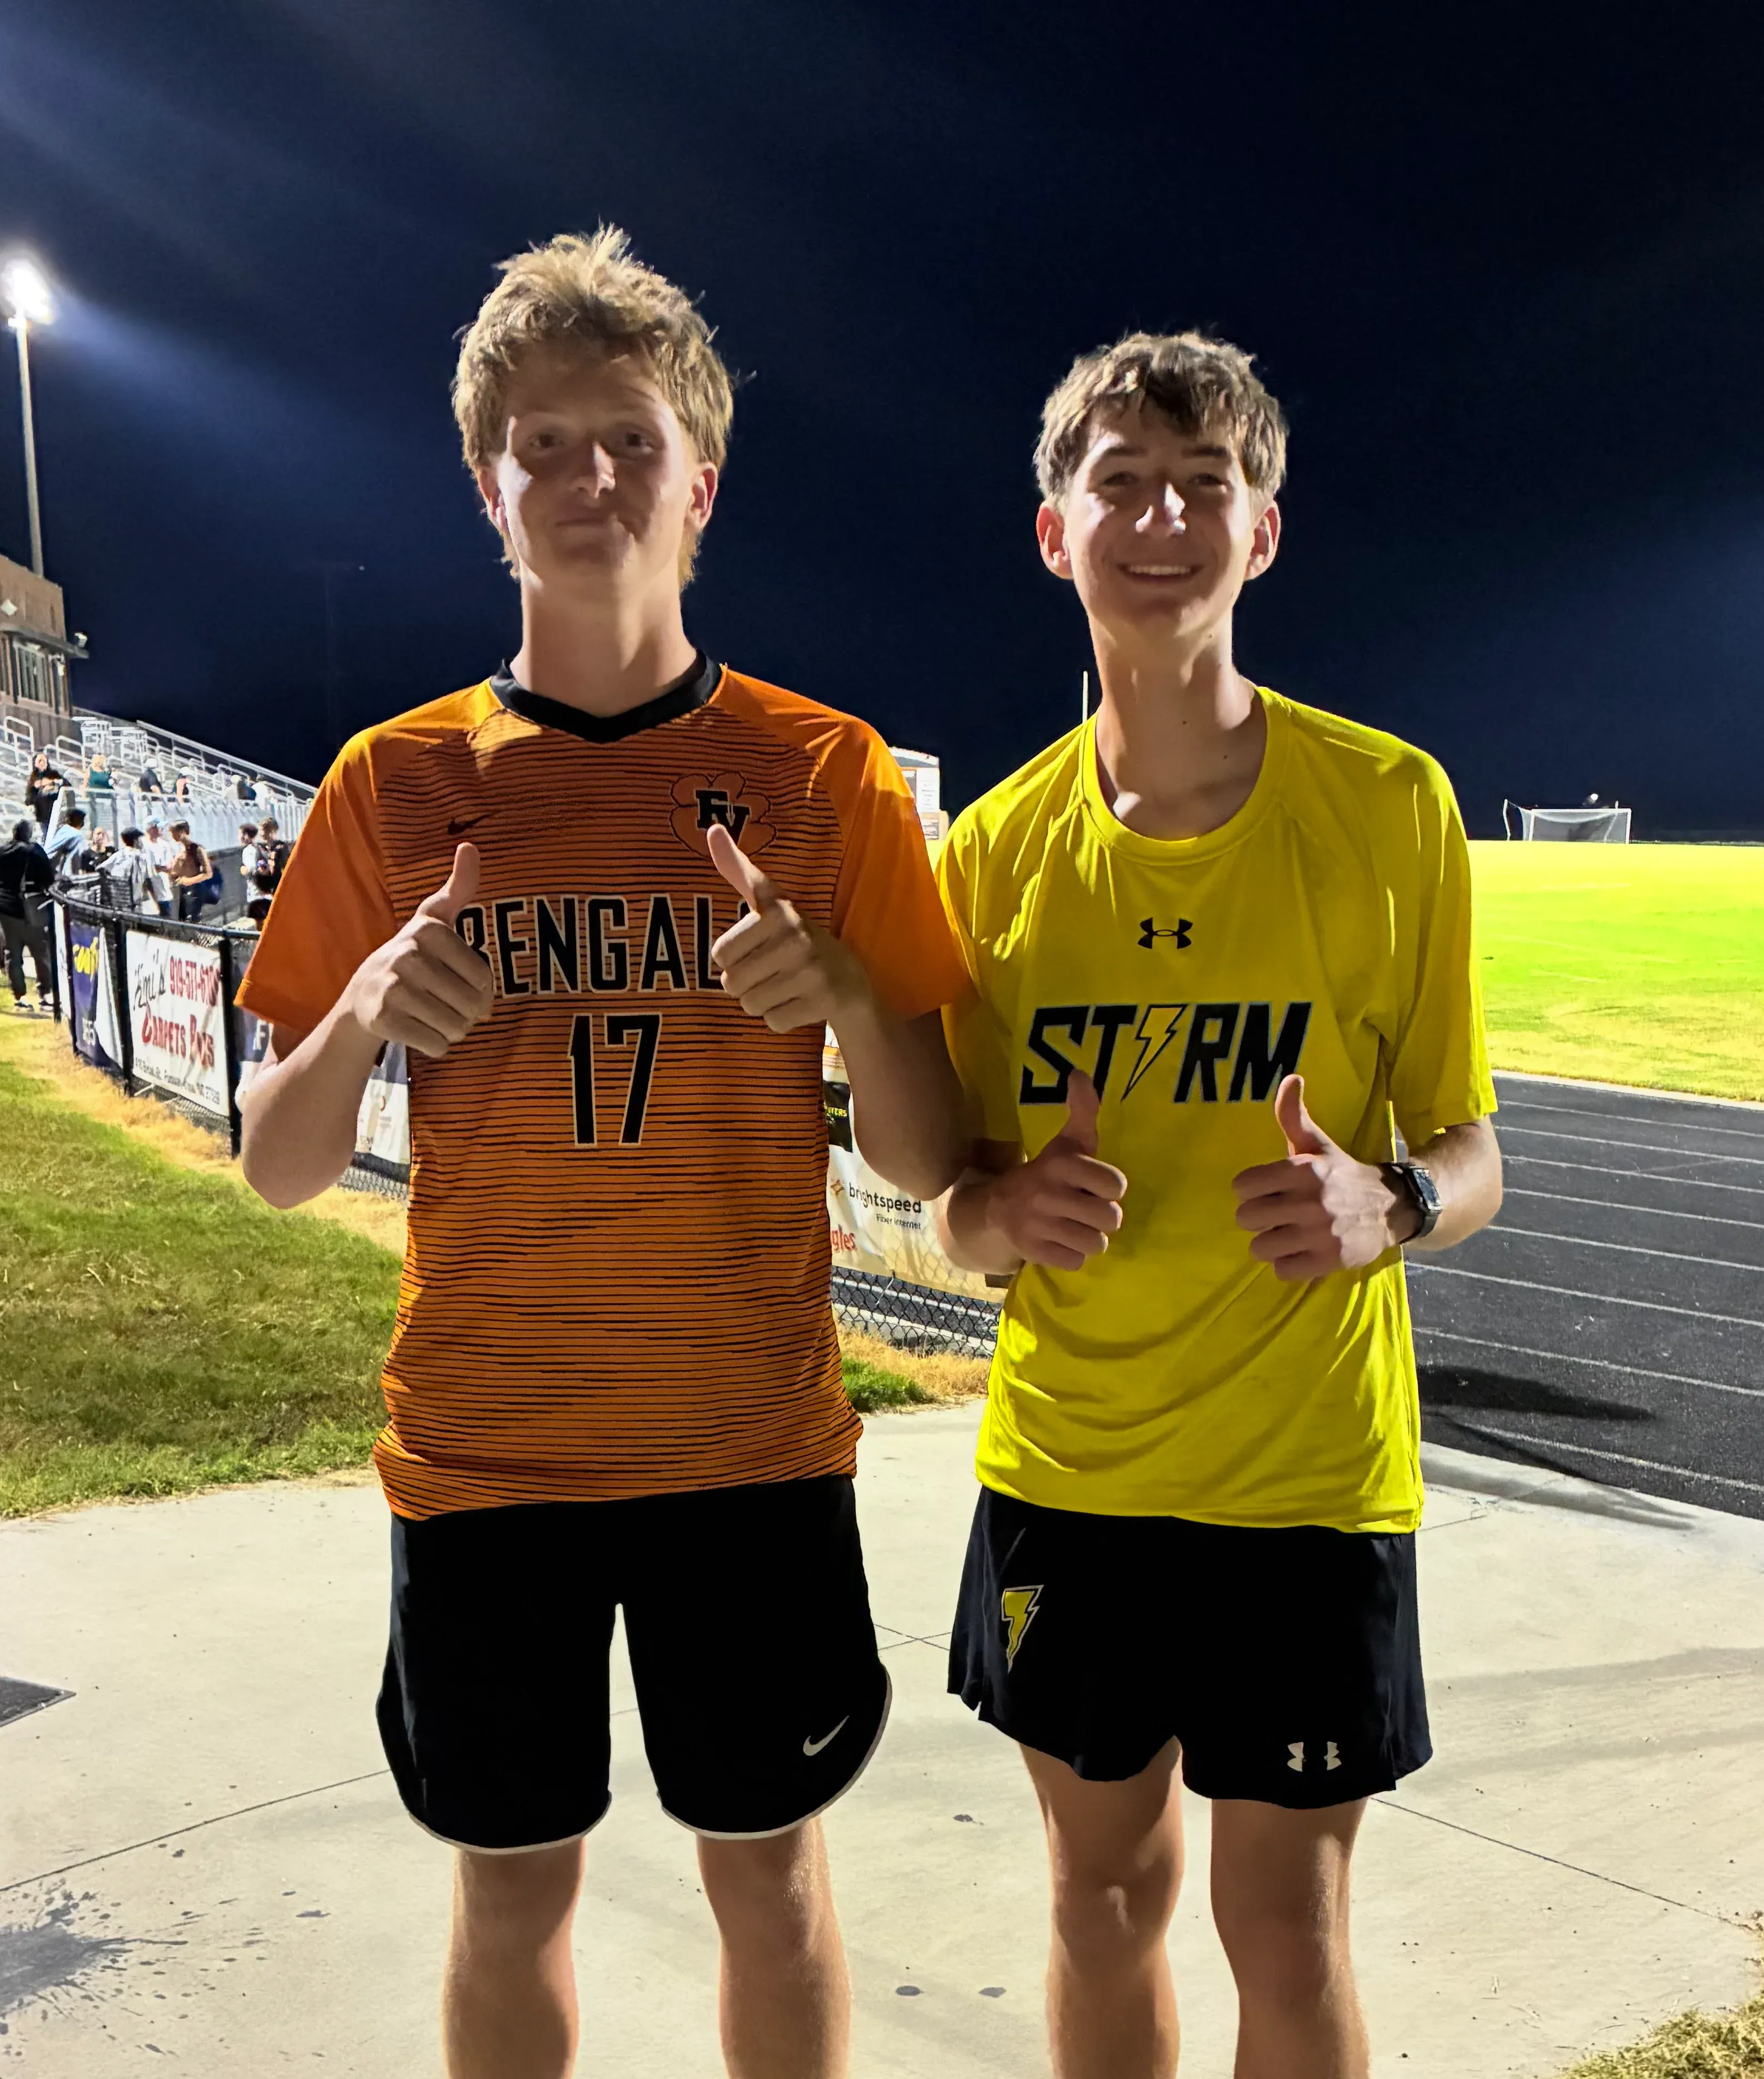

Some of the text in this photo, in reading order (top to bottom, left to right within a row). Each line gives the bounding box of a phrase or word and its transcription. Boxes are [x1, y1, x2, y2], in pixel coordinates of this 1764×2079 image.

[454, 893, 752, 999] BENGAL
[568, 1012, 663, 1147] 17
[849, 1182, 922, 1214] brightspeed
